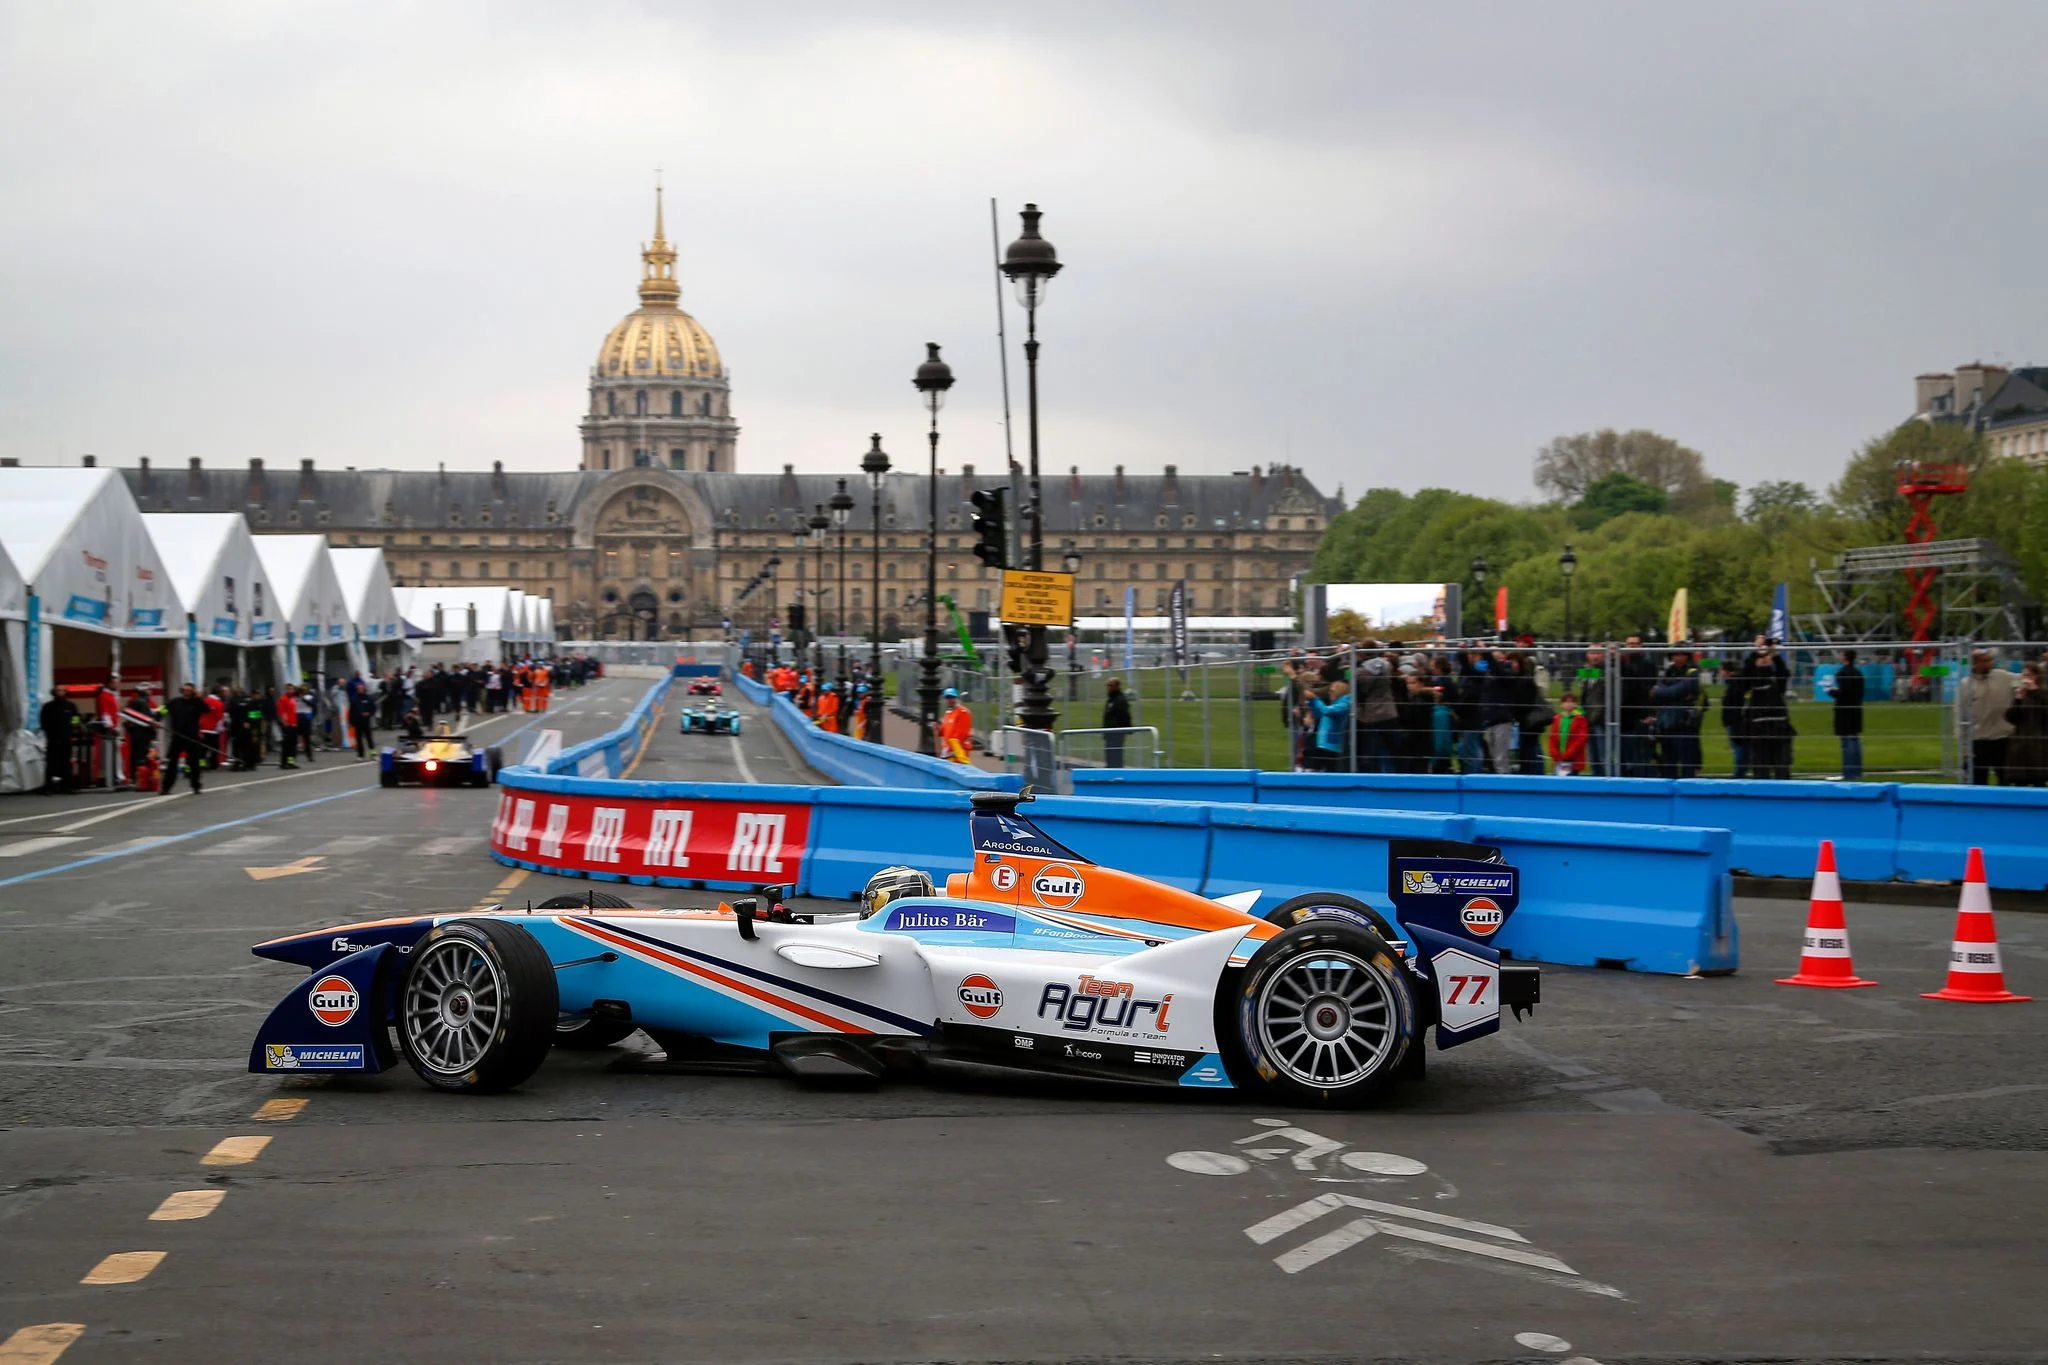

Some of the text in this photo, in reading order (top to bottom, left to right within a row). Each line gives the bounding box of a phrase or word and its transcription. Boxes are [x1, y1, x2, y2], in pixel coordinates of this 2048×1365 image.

[584, 806, 626, 863] RTL
[643, 809, 694, 868] RTL
[727, 812, 787, 873] RTL
[998, 869, 1010, 886] E
[1035, 879, 1080, 894] Gulf
[898, 913, 988, 930] Julius Bär
[1463, 911, 1500, 922] Gulf
[1078, 974, 1134, 998] Team
[1447, 975, 1491, 1004] 77
[312, 994, 355, 1008] Gulf
[960, 989, 1001, 1004] Gulf
[1037, 982, 1174, 1032] Aguri
[1091, 1028, 1130, 1037] Formula
[1142, 1032, 1167, 1041] Team
[1015, 1038, 1034, 1048] OMP
[300, 1051, 360, 1060] MICHELIN
[1152, 1053, 1185, 1061] INNOVATOR
[1152, 1059, 1185, 1067] CAPITAL
